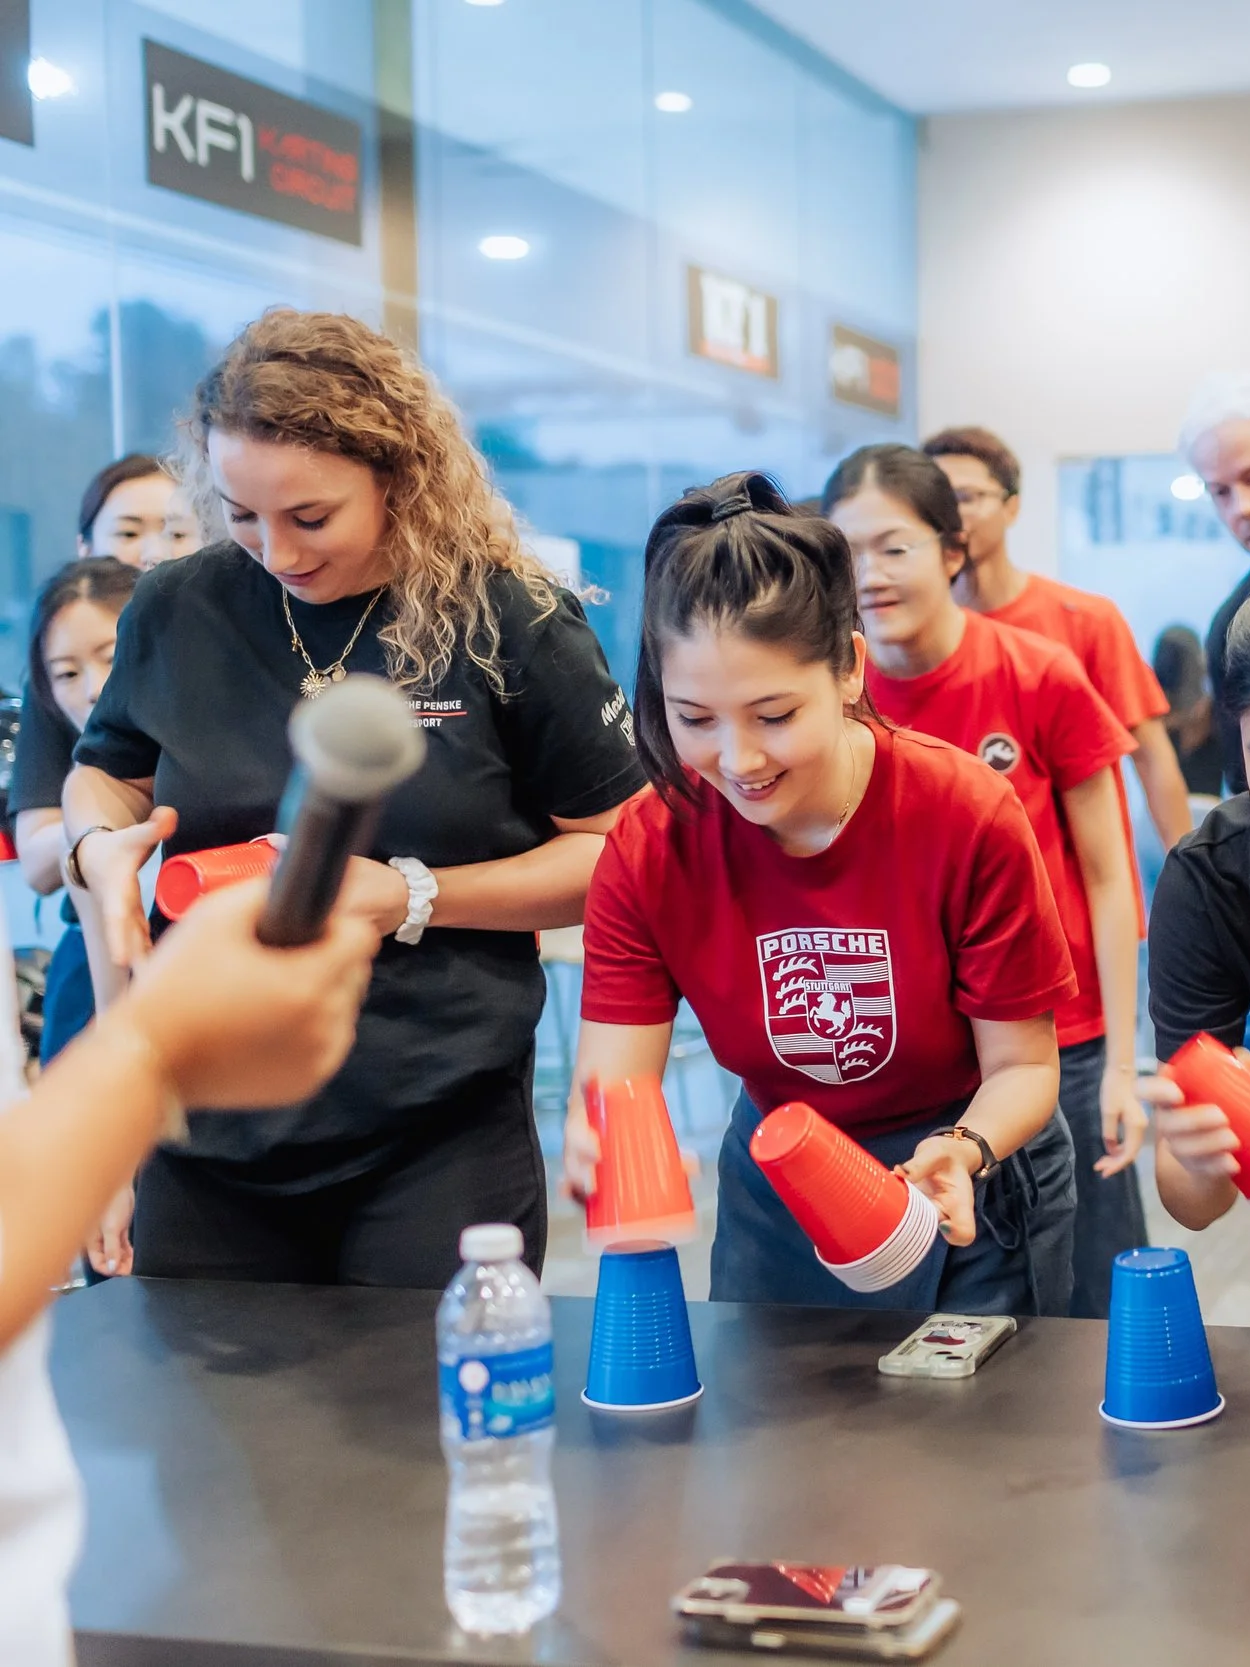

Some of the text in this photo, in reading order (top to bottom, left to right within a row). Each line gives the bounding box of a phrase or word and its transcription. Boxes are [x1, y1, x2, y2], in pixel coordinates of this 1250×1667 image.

[152, 81, 254, 182] KF1
[423, 699, 462, 710] PENSKE
[763, 933, 884, 959] PORSCHE
[805, 980, 851, 992] STUTTGART
